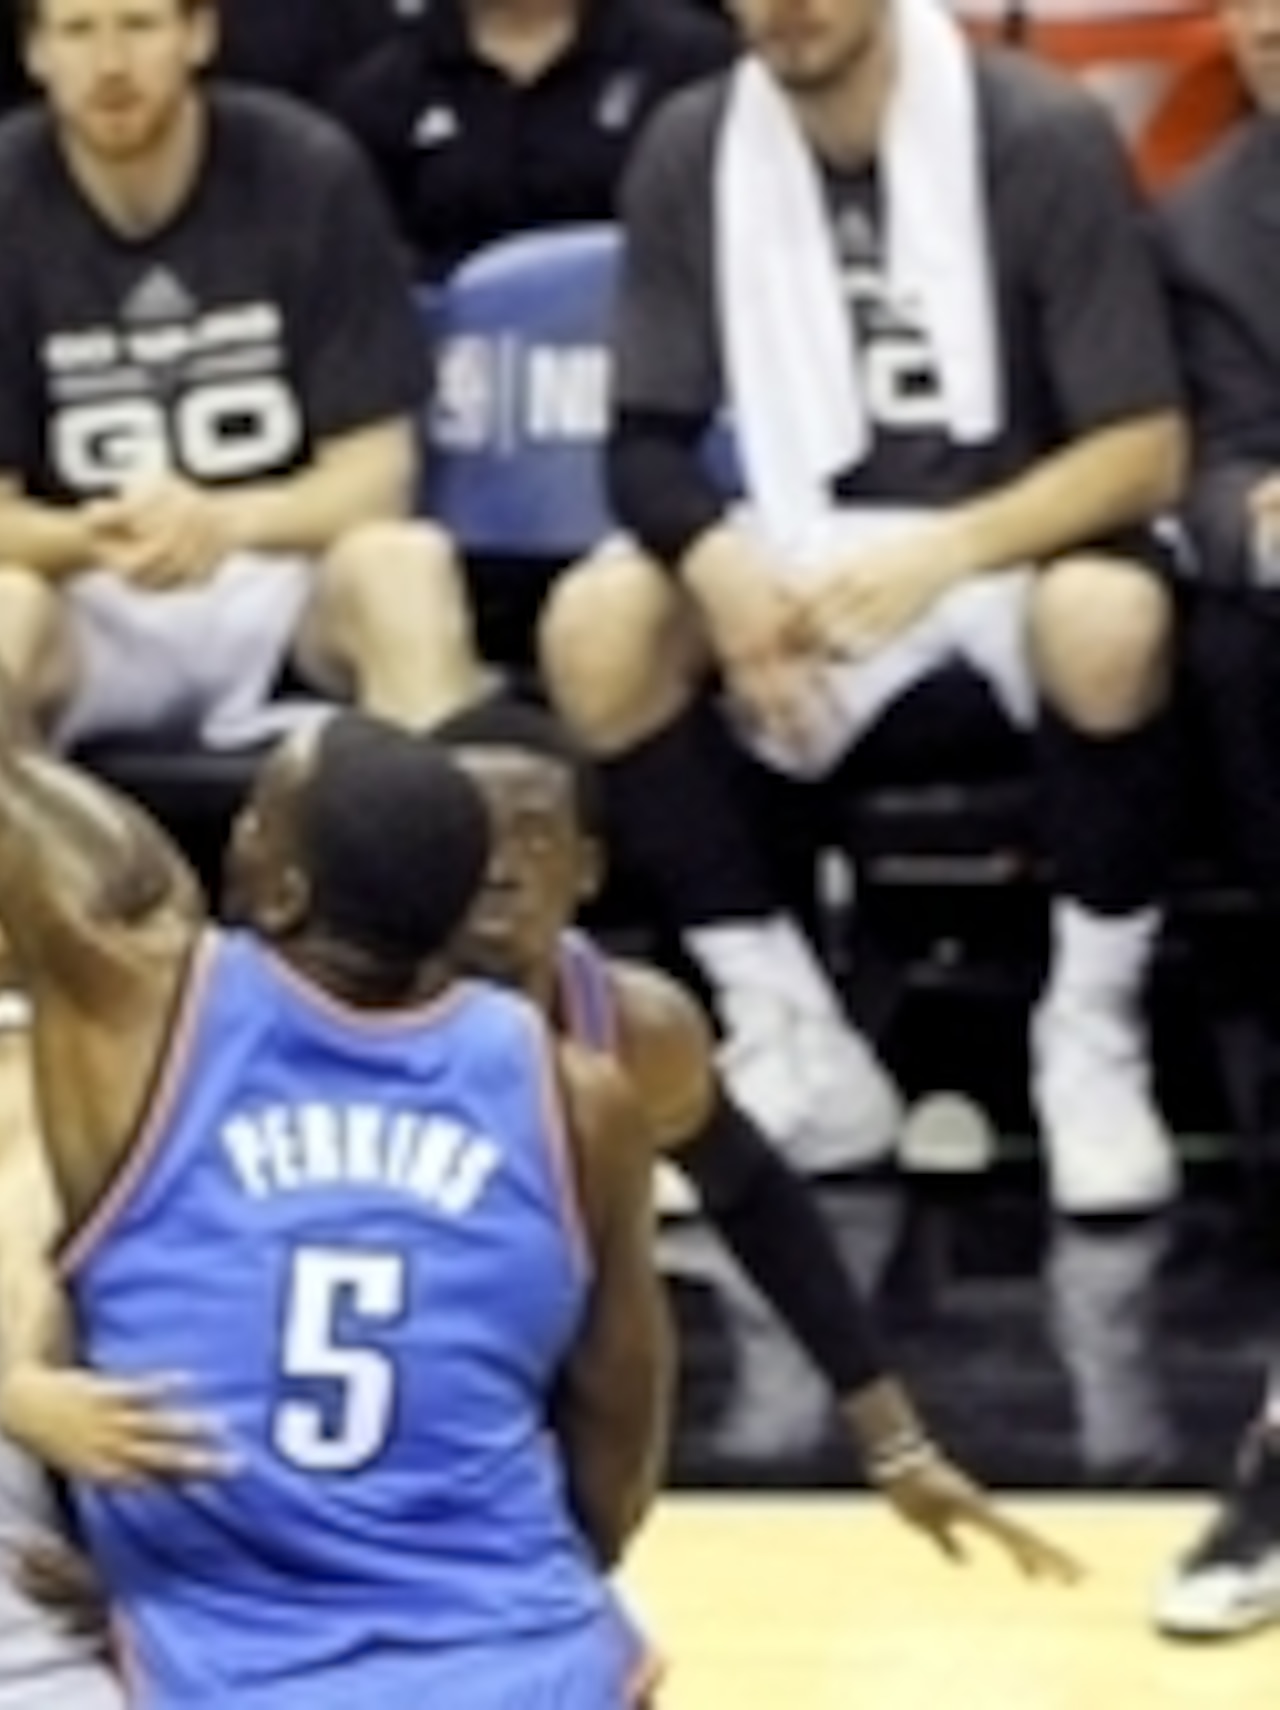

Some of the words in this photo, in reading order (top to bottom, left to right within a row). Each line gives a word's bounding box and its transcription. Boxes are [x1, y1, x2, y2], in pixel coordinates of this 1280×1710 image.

[51, 376, 303, 492] GO
[220, 1100, 502, 1218] PERKINS
[271, 1240, 406, 1475] 5
